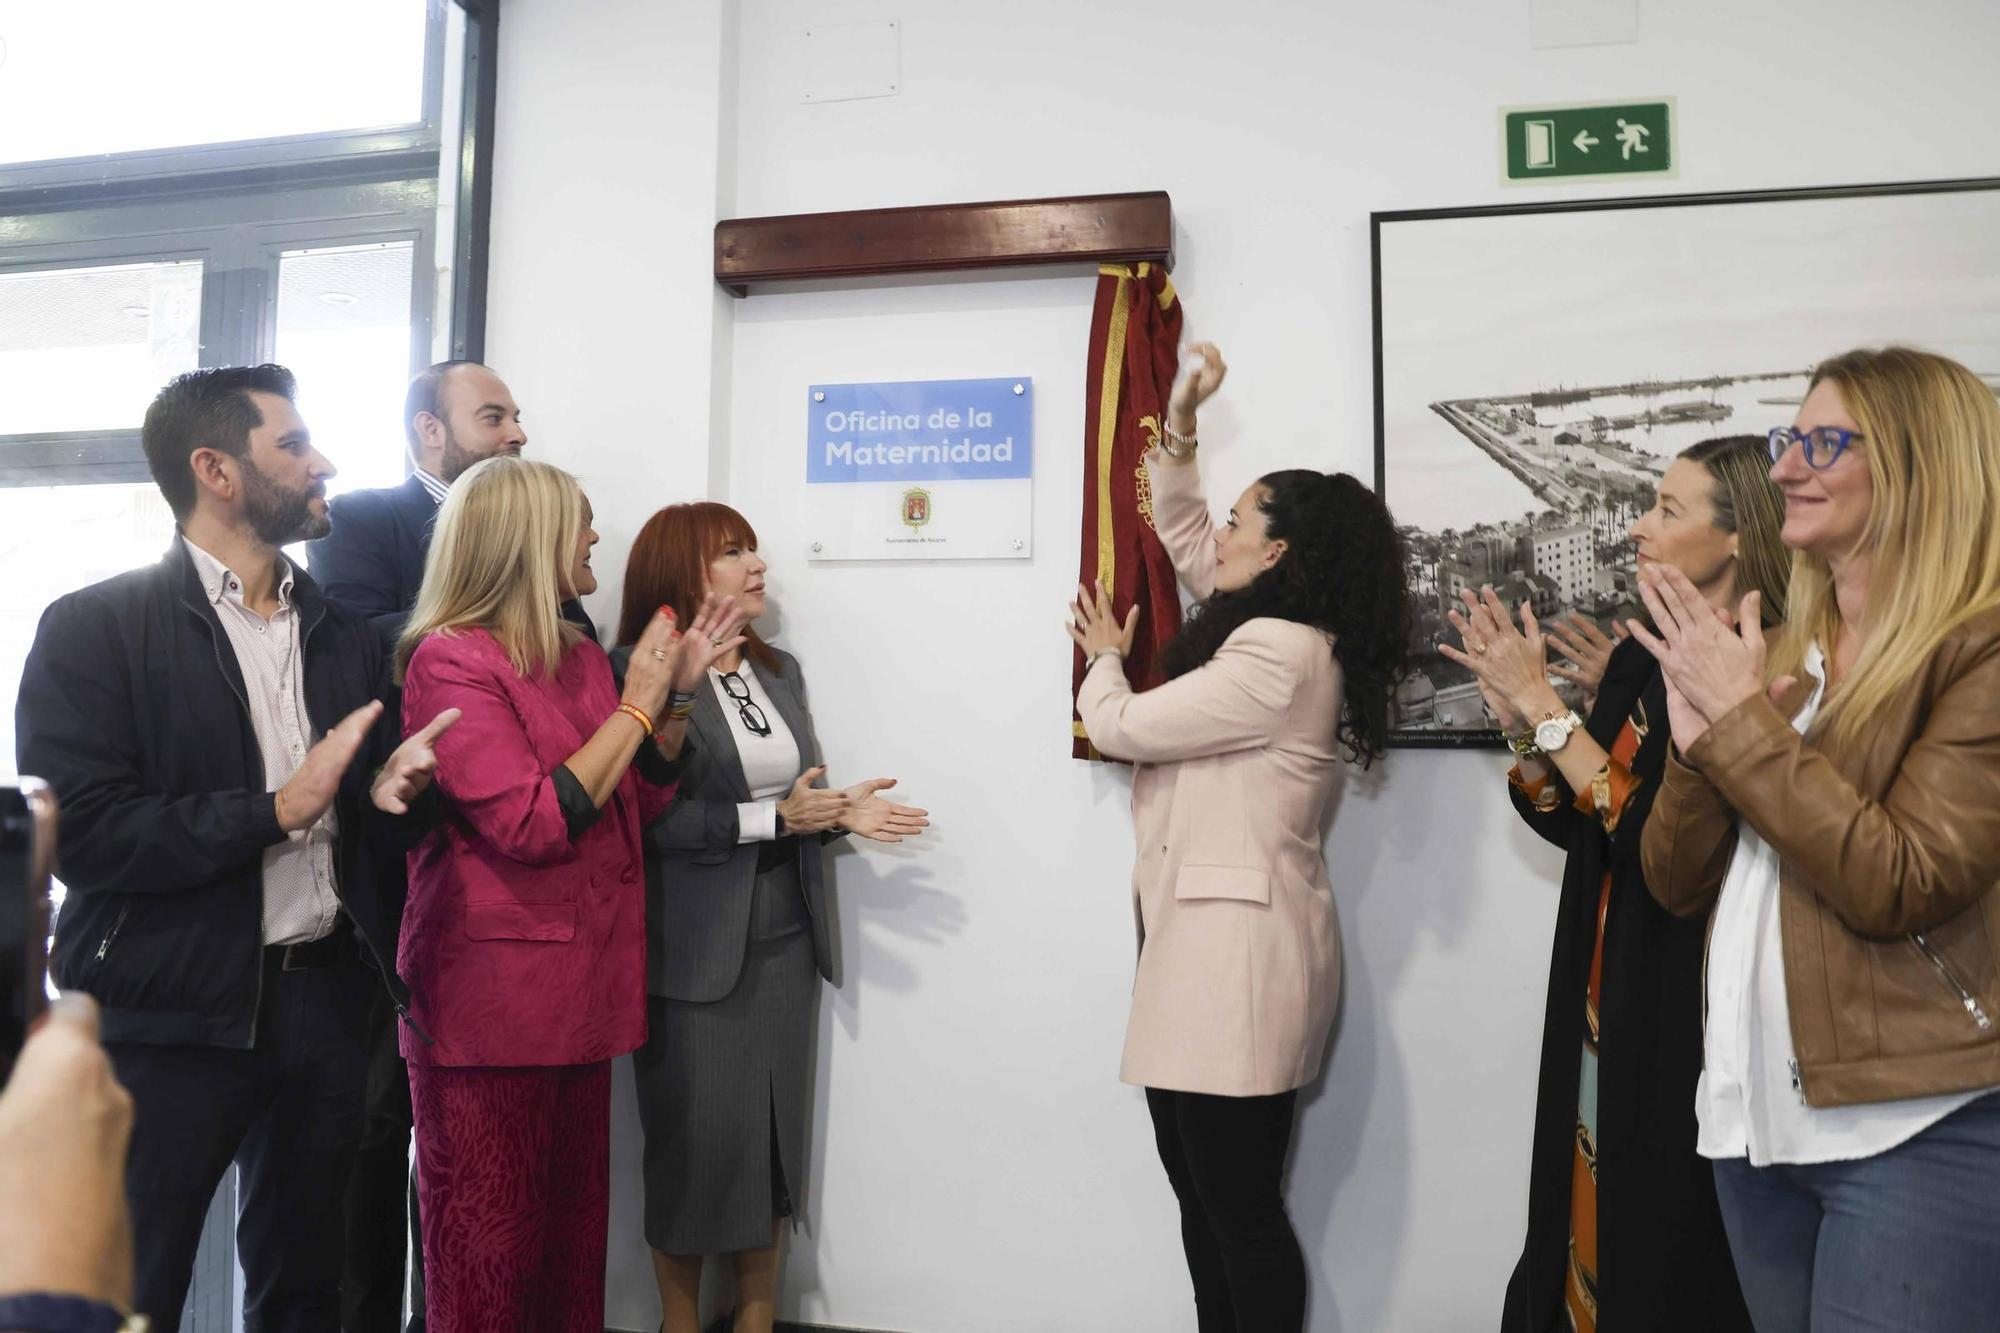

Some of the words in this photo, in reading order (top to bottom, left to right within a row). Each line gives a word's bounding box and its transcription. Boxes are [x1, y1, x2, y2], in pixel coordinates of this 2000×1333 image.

[825, 410, 920, 433] Oficina
[927, 408, 961, 429] de
[968, 407, 993, 428] la
[825, 437, 1013, 466] Maternidad
